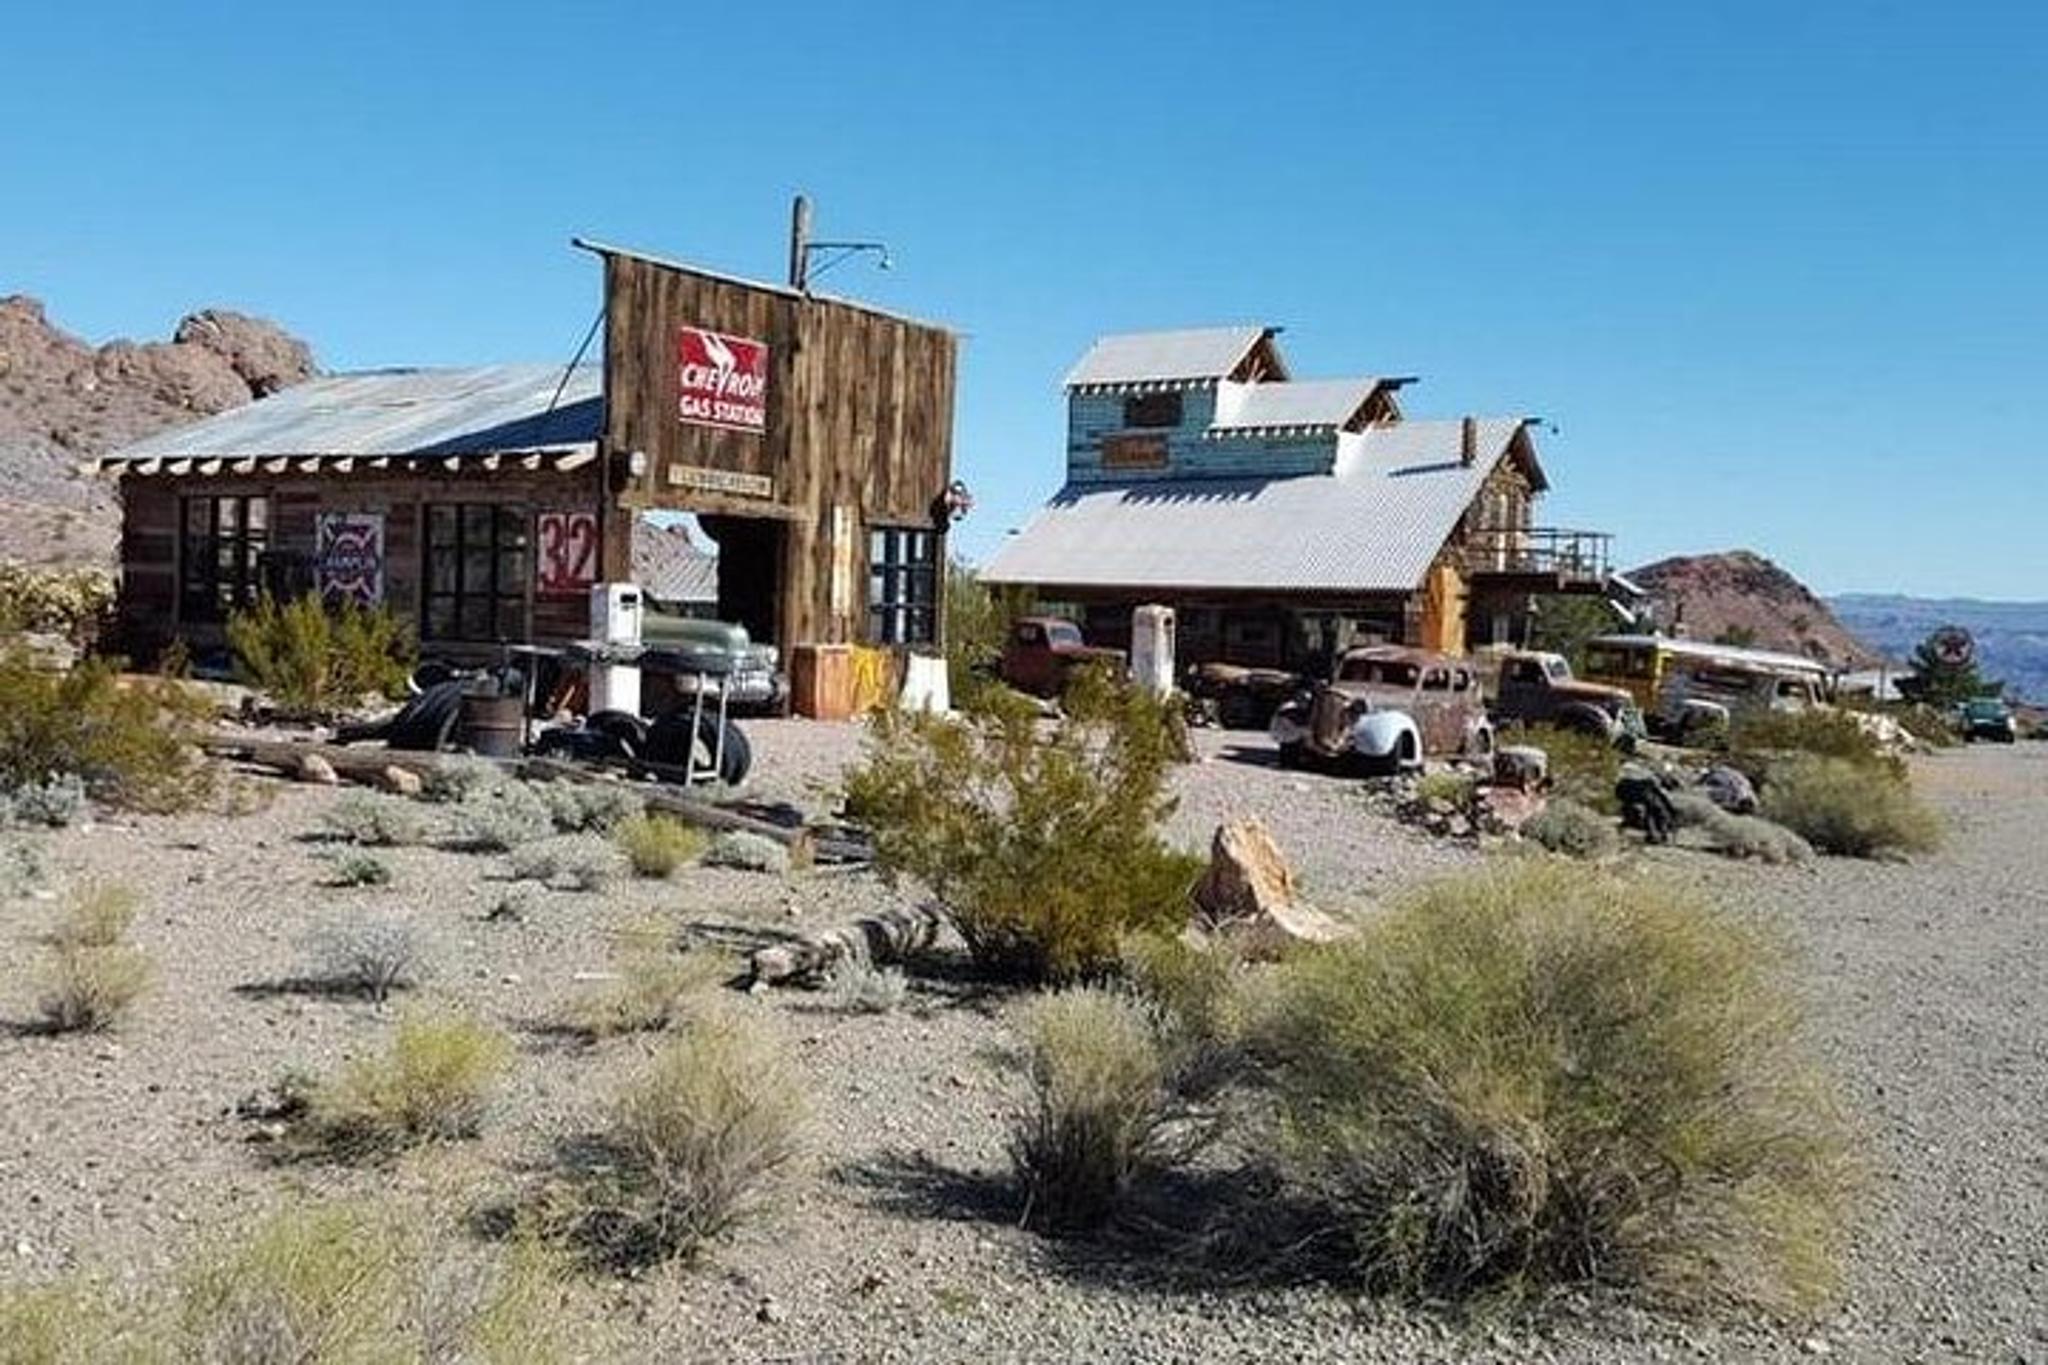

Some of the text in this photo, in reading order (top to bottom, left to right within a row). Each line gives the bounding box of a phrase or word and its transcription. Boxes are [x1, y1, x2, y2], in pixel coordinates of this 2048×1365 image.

[682, 364, 765, 398] CHEVRON
[680, 395, 765, 425] GAS STATION
[540, 517, 597, 588] 32
